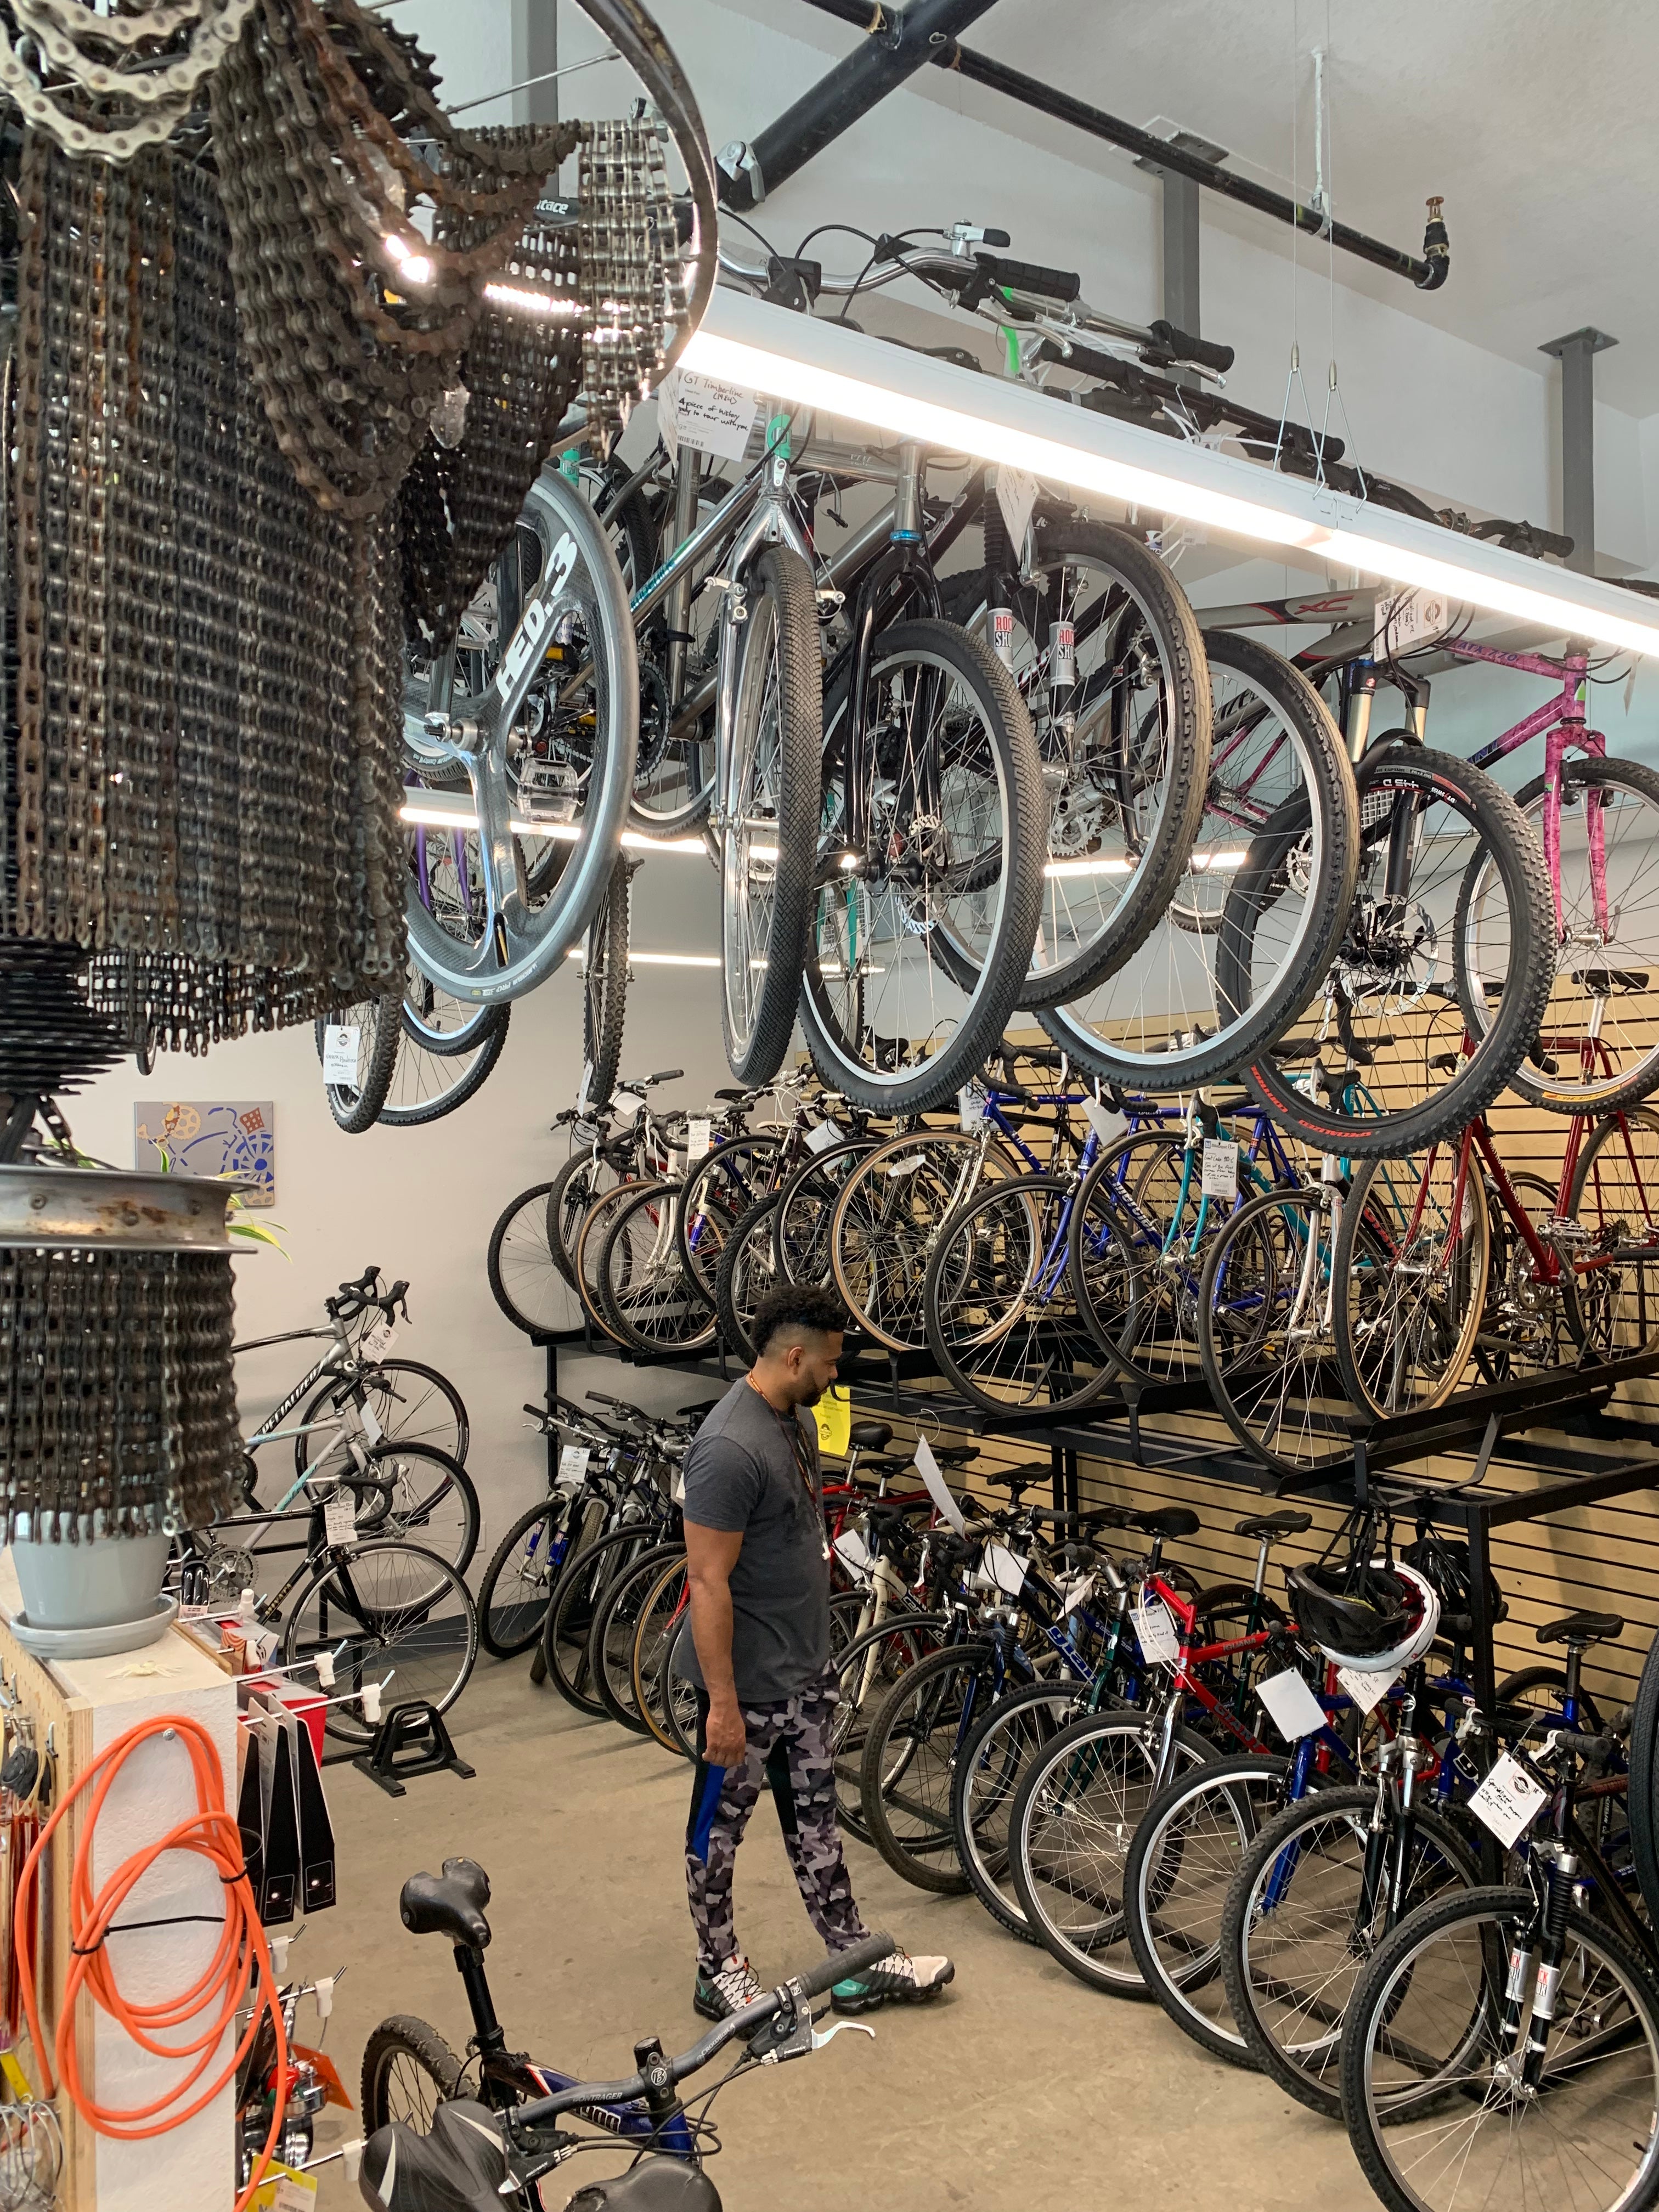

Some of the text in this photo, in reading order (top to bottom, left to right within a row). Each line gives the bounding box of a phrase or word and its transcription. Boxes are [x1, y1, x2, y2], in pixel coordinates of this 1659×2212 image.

[684, 372, 699, 385] GT
[995, 616, 1012, 631] ROC
[995, 631, 1012, 648] SHO
[1059, 628, 1074, 645] ROC
[1058, 644, 1074, 659] SHO
[1457, 641, 1519, 662] ATX 770
[1250, 1064, 1289, 1113] CONTROL
[1298, 1119, 1373, 1138] SPECIALIZED
[260, 1364, 320, 1434] PECIALIZED
[1538, 1968, 1549, 1984] CK
[1536, 1980, 1548, 1997] OX
[572, 2092, 623, 2102] BONTRAGER
[576, 2105, 621, 2135] 900
